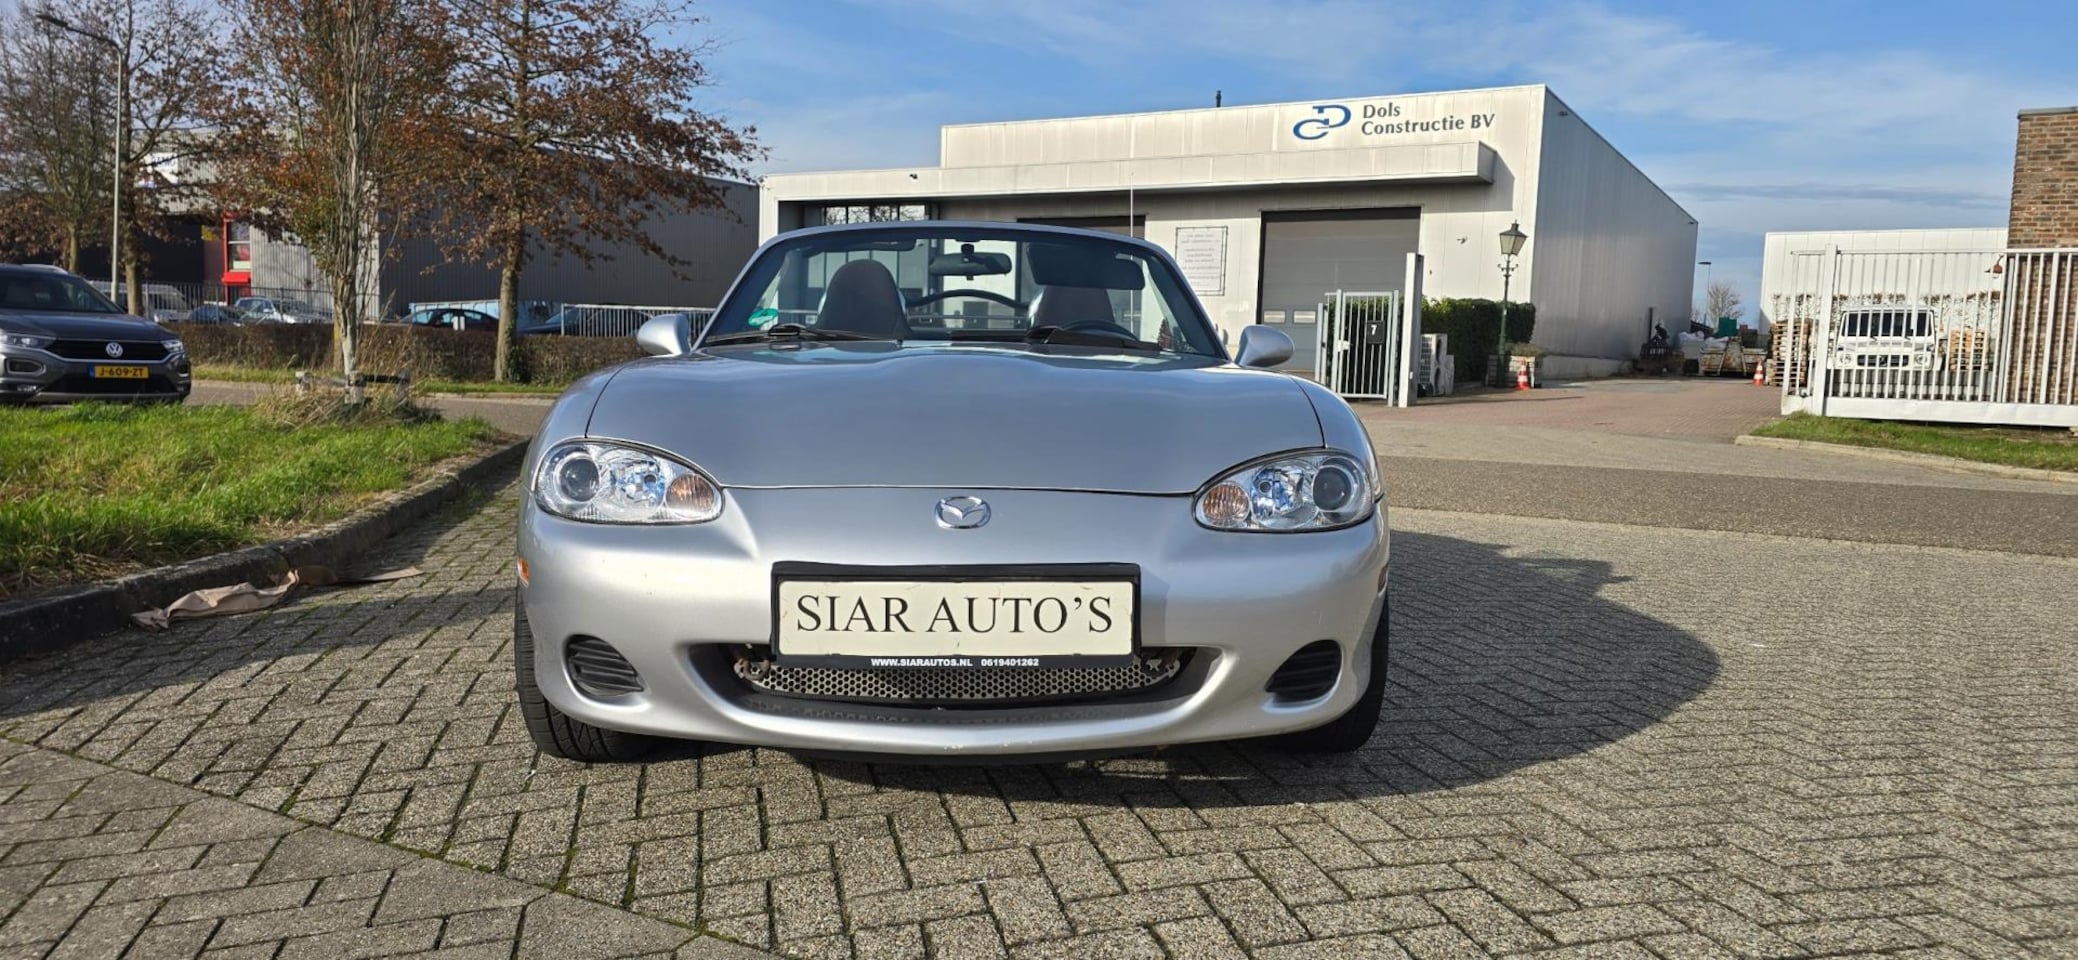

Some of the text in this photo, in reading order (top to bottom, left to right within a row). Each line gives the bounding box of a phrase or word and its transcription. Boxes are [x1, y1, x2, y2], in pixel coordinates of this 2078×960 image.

[1363, 102, 1401, 119] Dols
[1361, 113, 1496, 136] Constructie BV
[1370, 324, 1377, 335] 7
[797, 594, 1113, 633] SIAR AUTO'S
[871, 657, 1039, 667] WWW.SIARAUTOS.NL 0619401262
